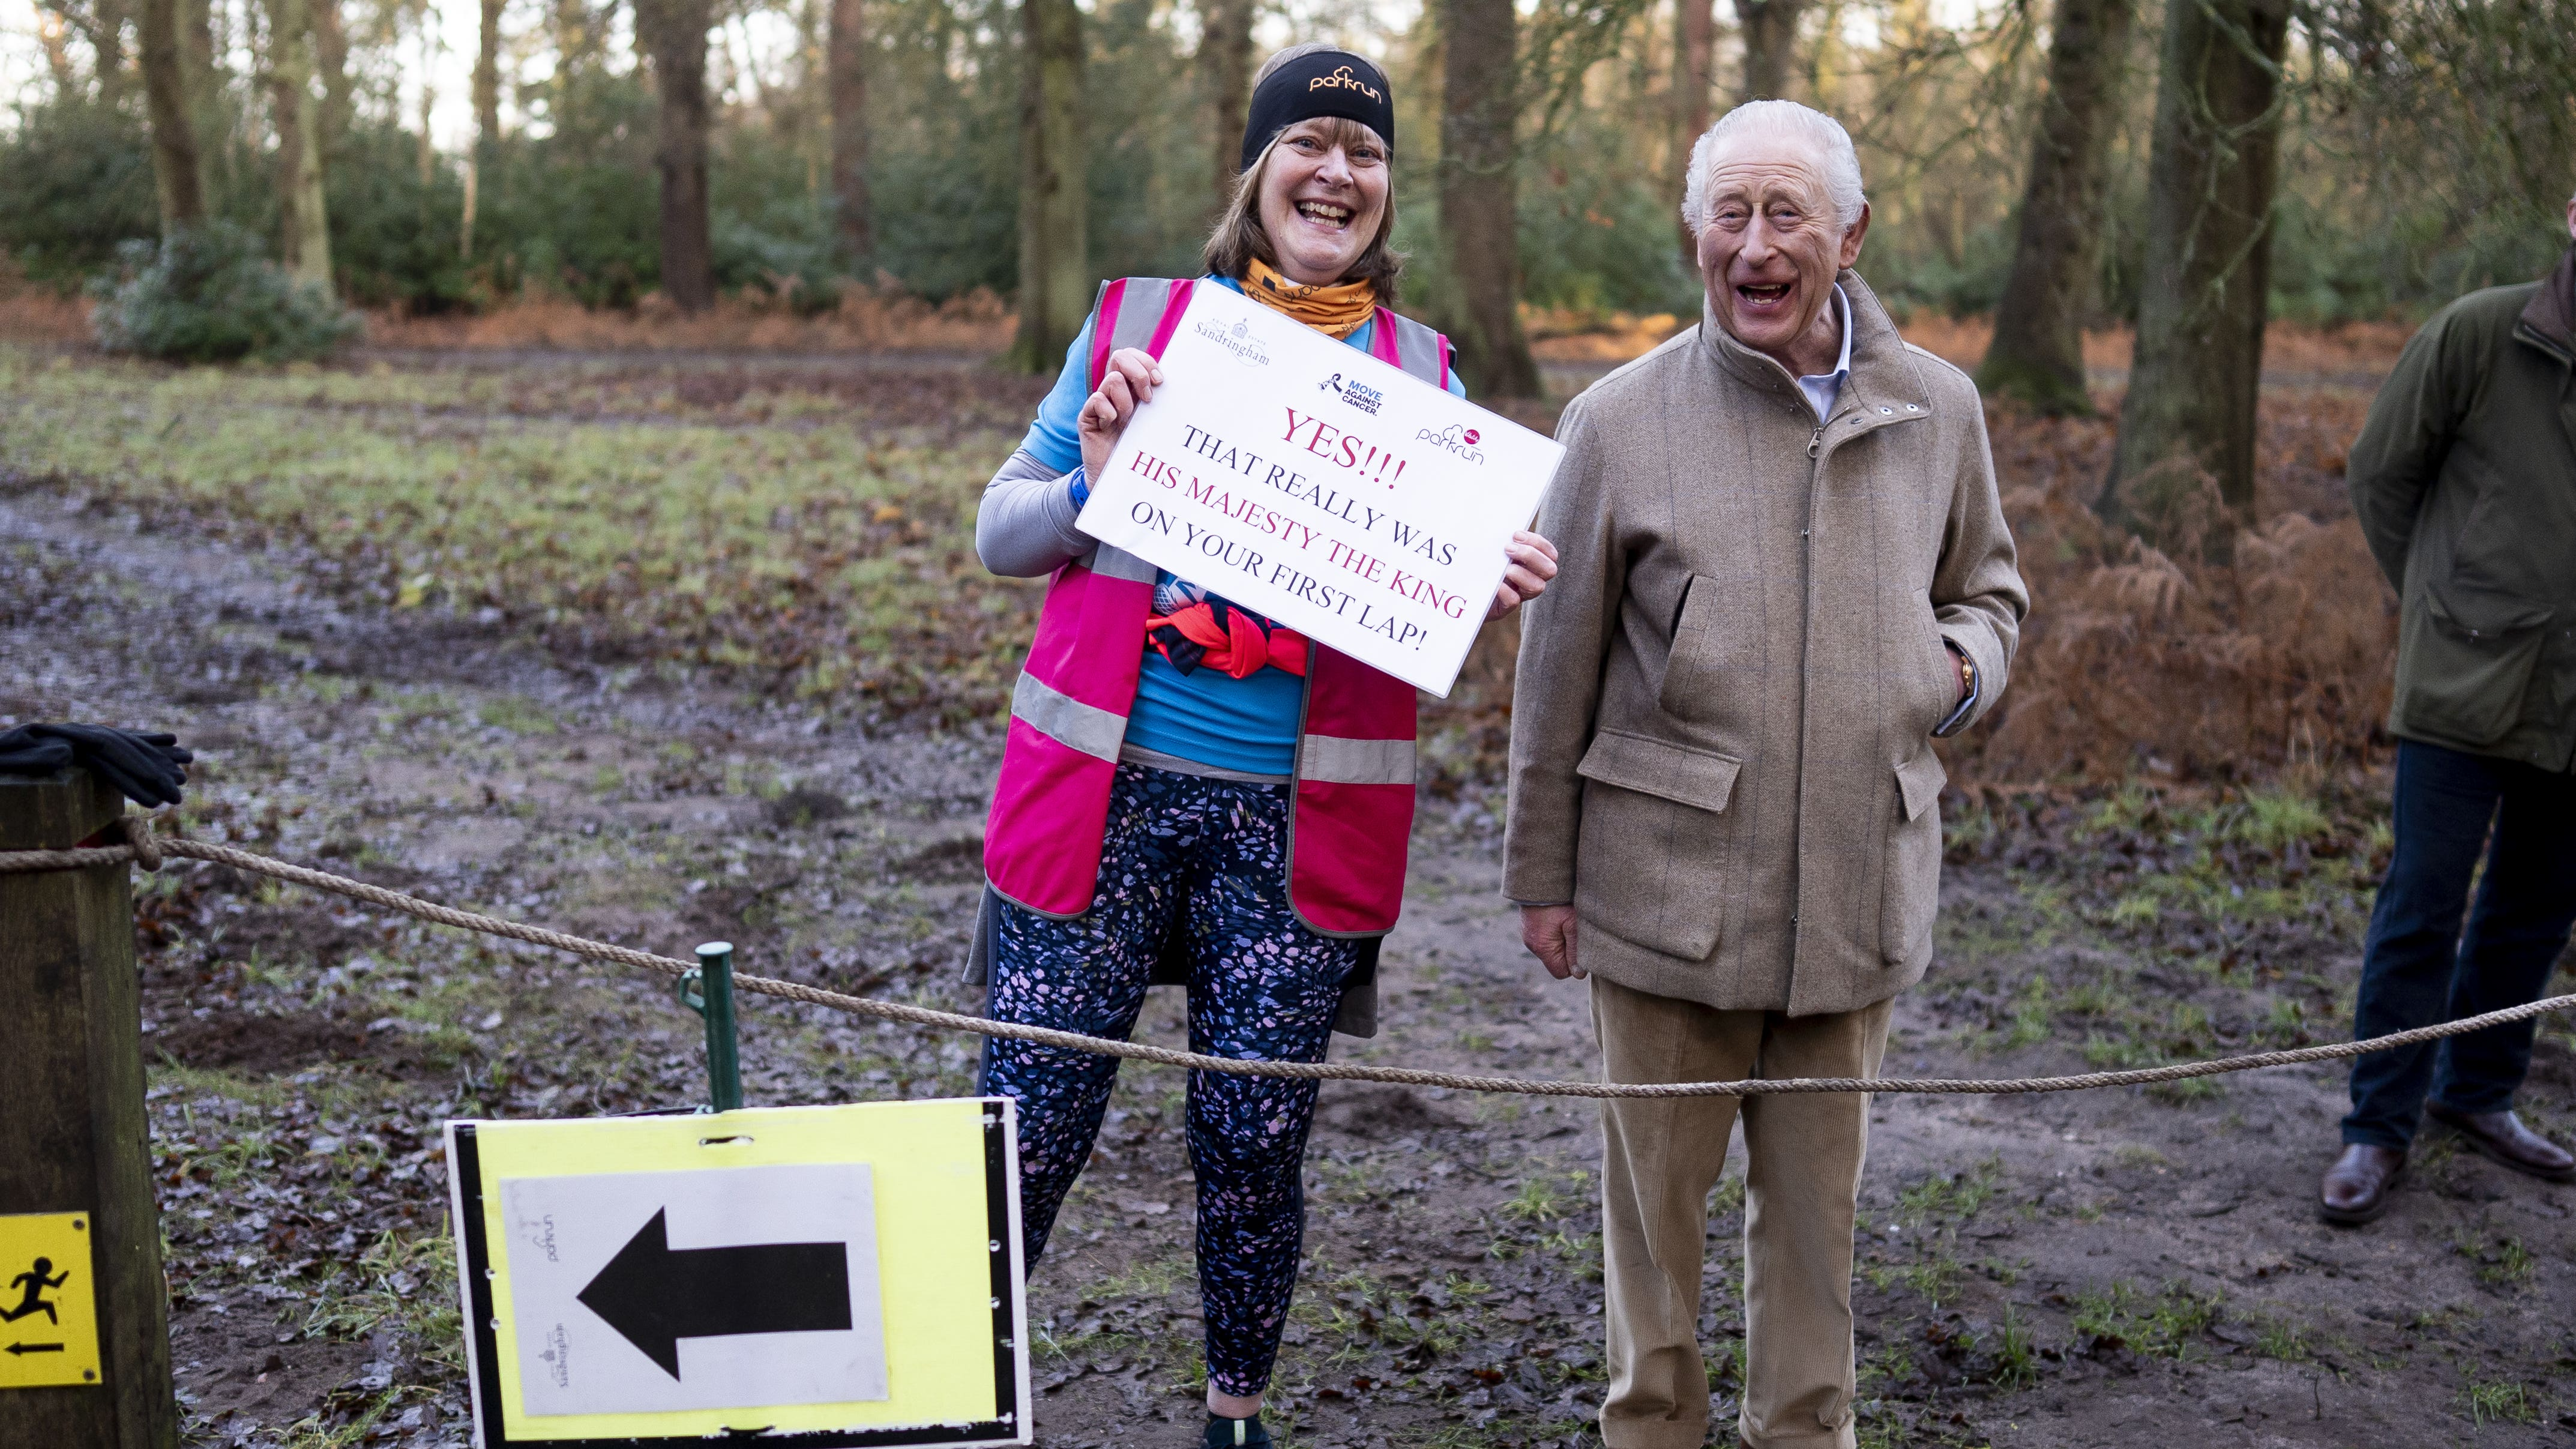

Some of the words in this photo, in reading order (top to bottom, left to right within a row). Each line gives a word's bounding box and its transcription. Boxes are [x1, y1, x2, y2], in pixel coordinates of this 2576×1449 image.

[1310, 65, 1382, 104] parkrun
[1194, 322, 1269, 365] Sandringham
[1342, 396, 1377, 416] CANCER.
[1344, 391, 1382, 409] AGAINST
[1349, 380, 1383, 401] MOVE
[1281, 407, 1406, 490] YES!!!
[1415, 424, 1484, 465] parkrun
[1183, 424, 1263, 476] THAT
[1264, 463, 1386, 531] REALLY
[1394, 520, 1457, 565] WAS
[1130, 450, 1182, 489] HIS
[1184, 476, 1322, 550] MAJESTY
[1328, 539, 1386, 583] THE
[1389, 569, 1467, 618] KING
[1131, 501, 1177, 536] ON
[1184, 522, 1263, 577] YOUR
[1269, 563, 1356, 616] FIRST
[1357, 604, 1427, 651] LAP!
[537, 1214, 561, 1262] parkrun
